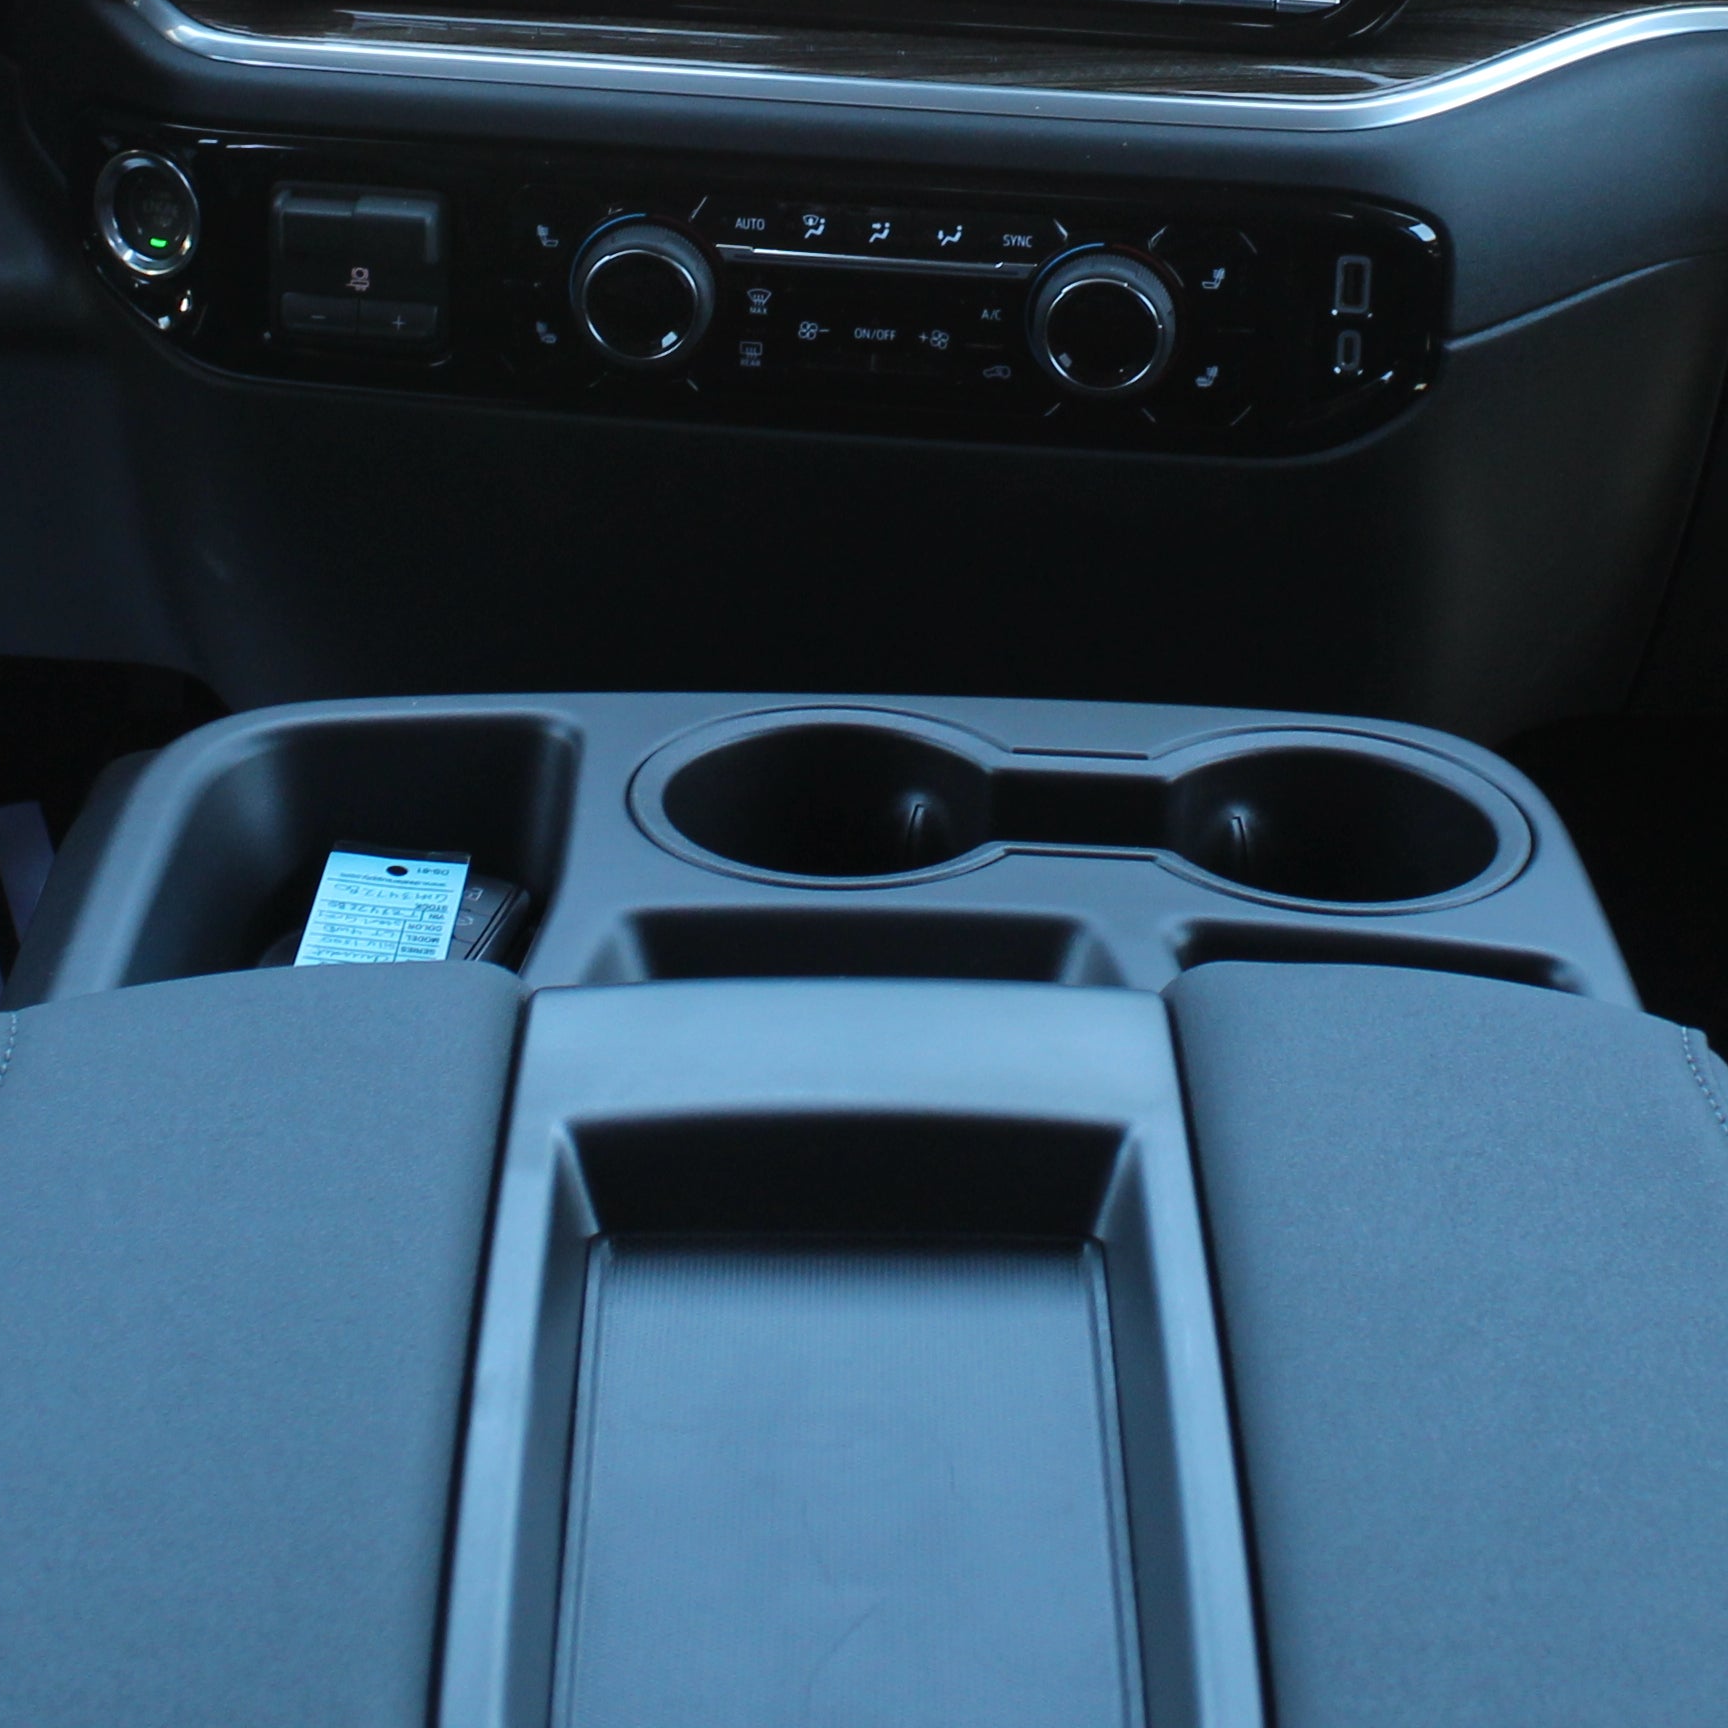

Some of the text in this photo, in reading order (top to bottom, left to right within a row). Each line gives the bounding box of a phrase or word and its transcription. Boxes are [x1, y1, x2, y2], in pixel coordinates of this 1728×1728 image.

[735, 218, 765, 230] AUTO
[1002, 234, 1033, 248] SYNC
[981, 309, 1002, 320] A/C
[854, 328, 897, 341] ON/OFF
[415, 903, 448, 912] STOCK
[407, 924, 443, 932] COLOR
[406, 935, 440, 943] MODEL
[401, 947, 436, 955] SERIES
